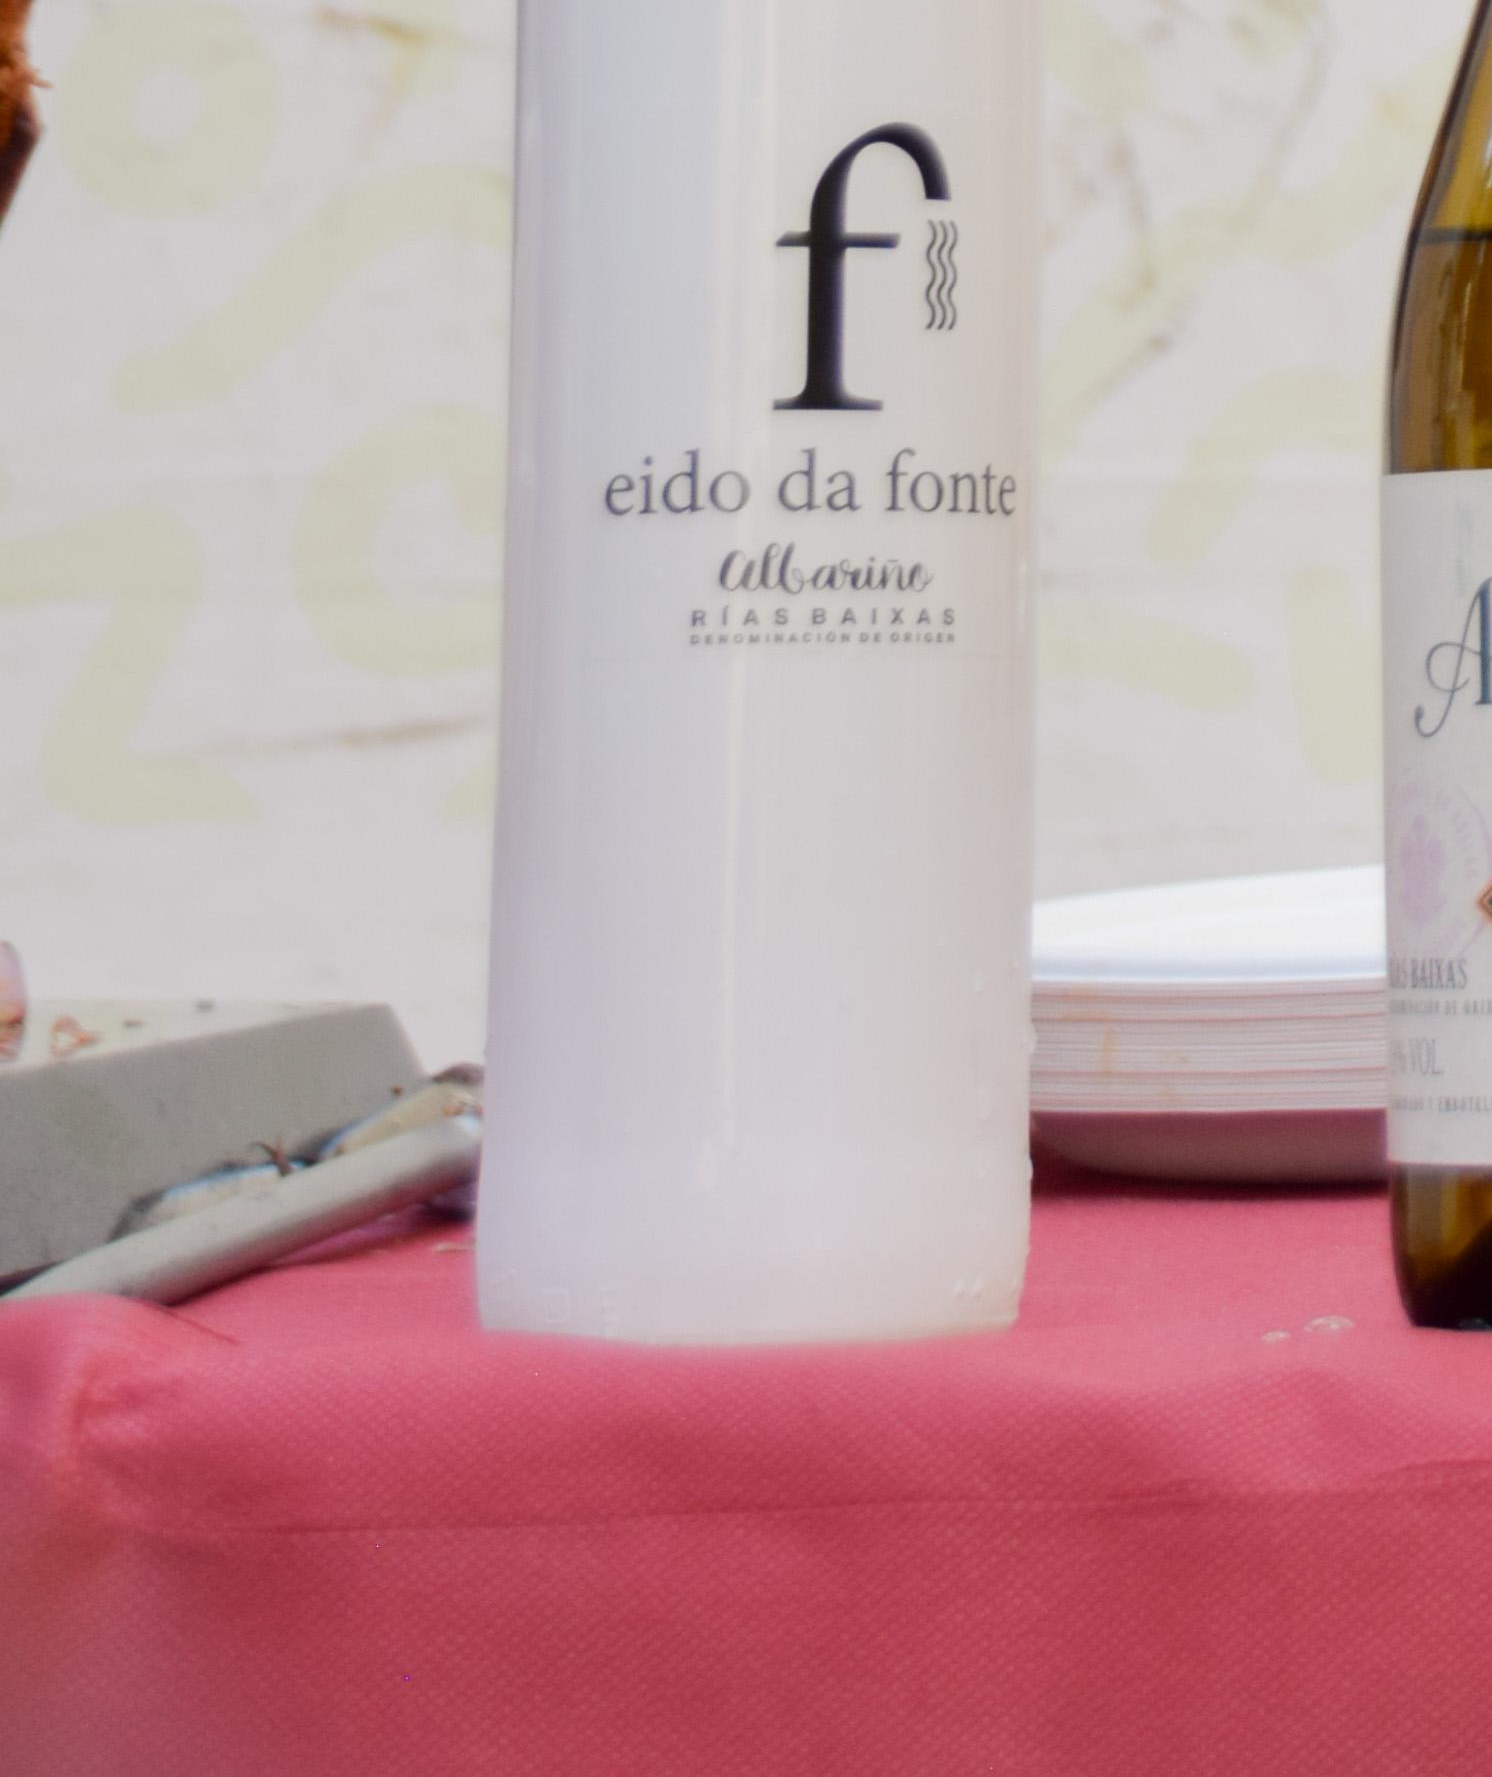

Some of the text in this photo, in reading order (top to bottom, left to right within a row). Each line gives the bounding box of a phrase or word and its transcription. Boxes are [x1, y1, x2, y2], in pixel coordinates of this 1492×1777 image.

[604, 447, 1017, 517] eido da fonte
[690, 606, 956, 628] RÍAS BAIXAS
[859, 632, 882, 644] DE
[889, 631, 956, 644] ORIGEN
[1410, 956, 1468, 991] BAIXAS
